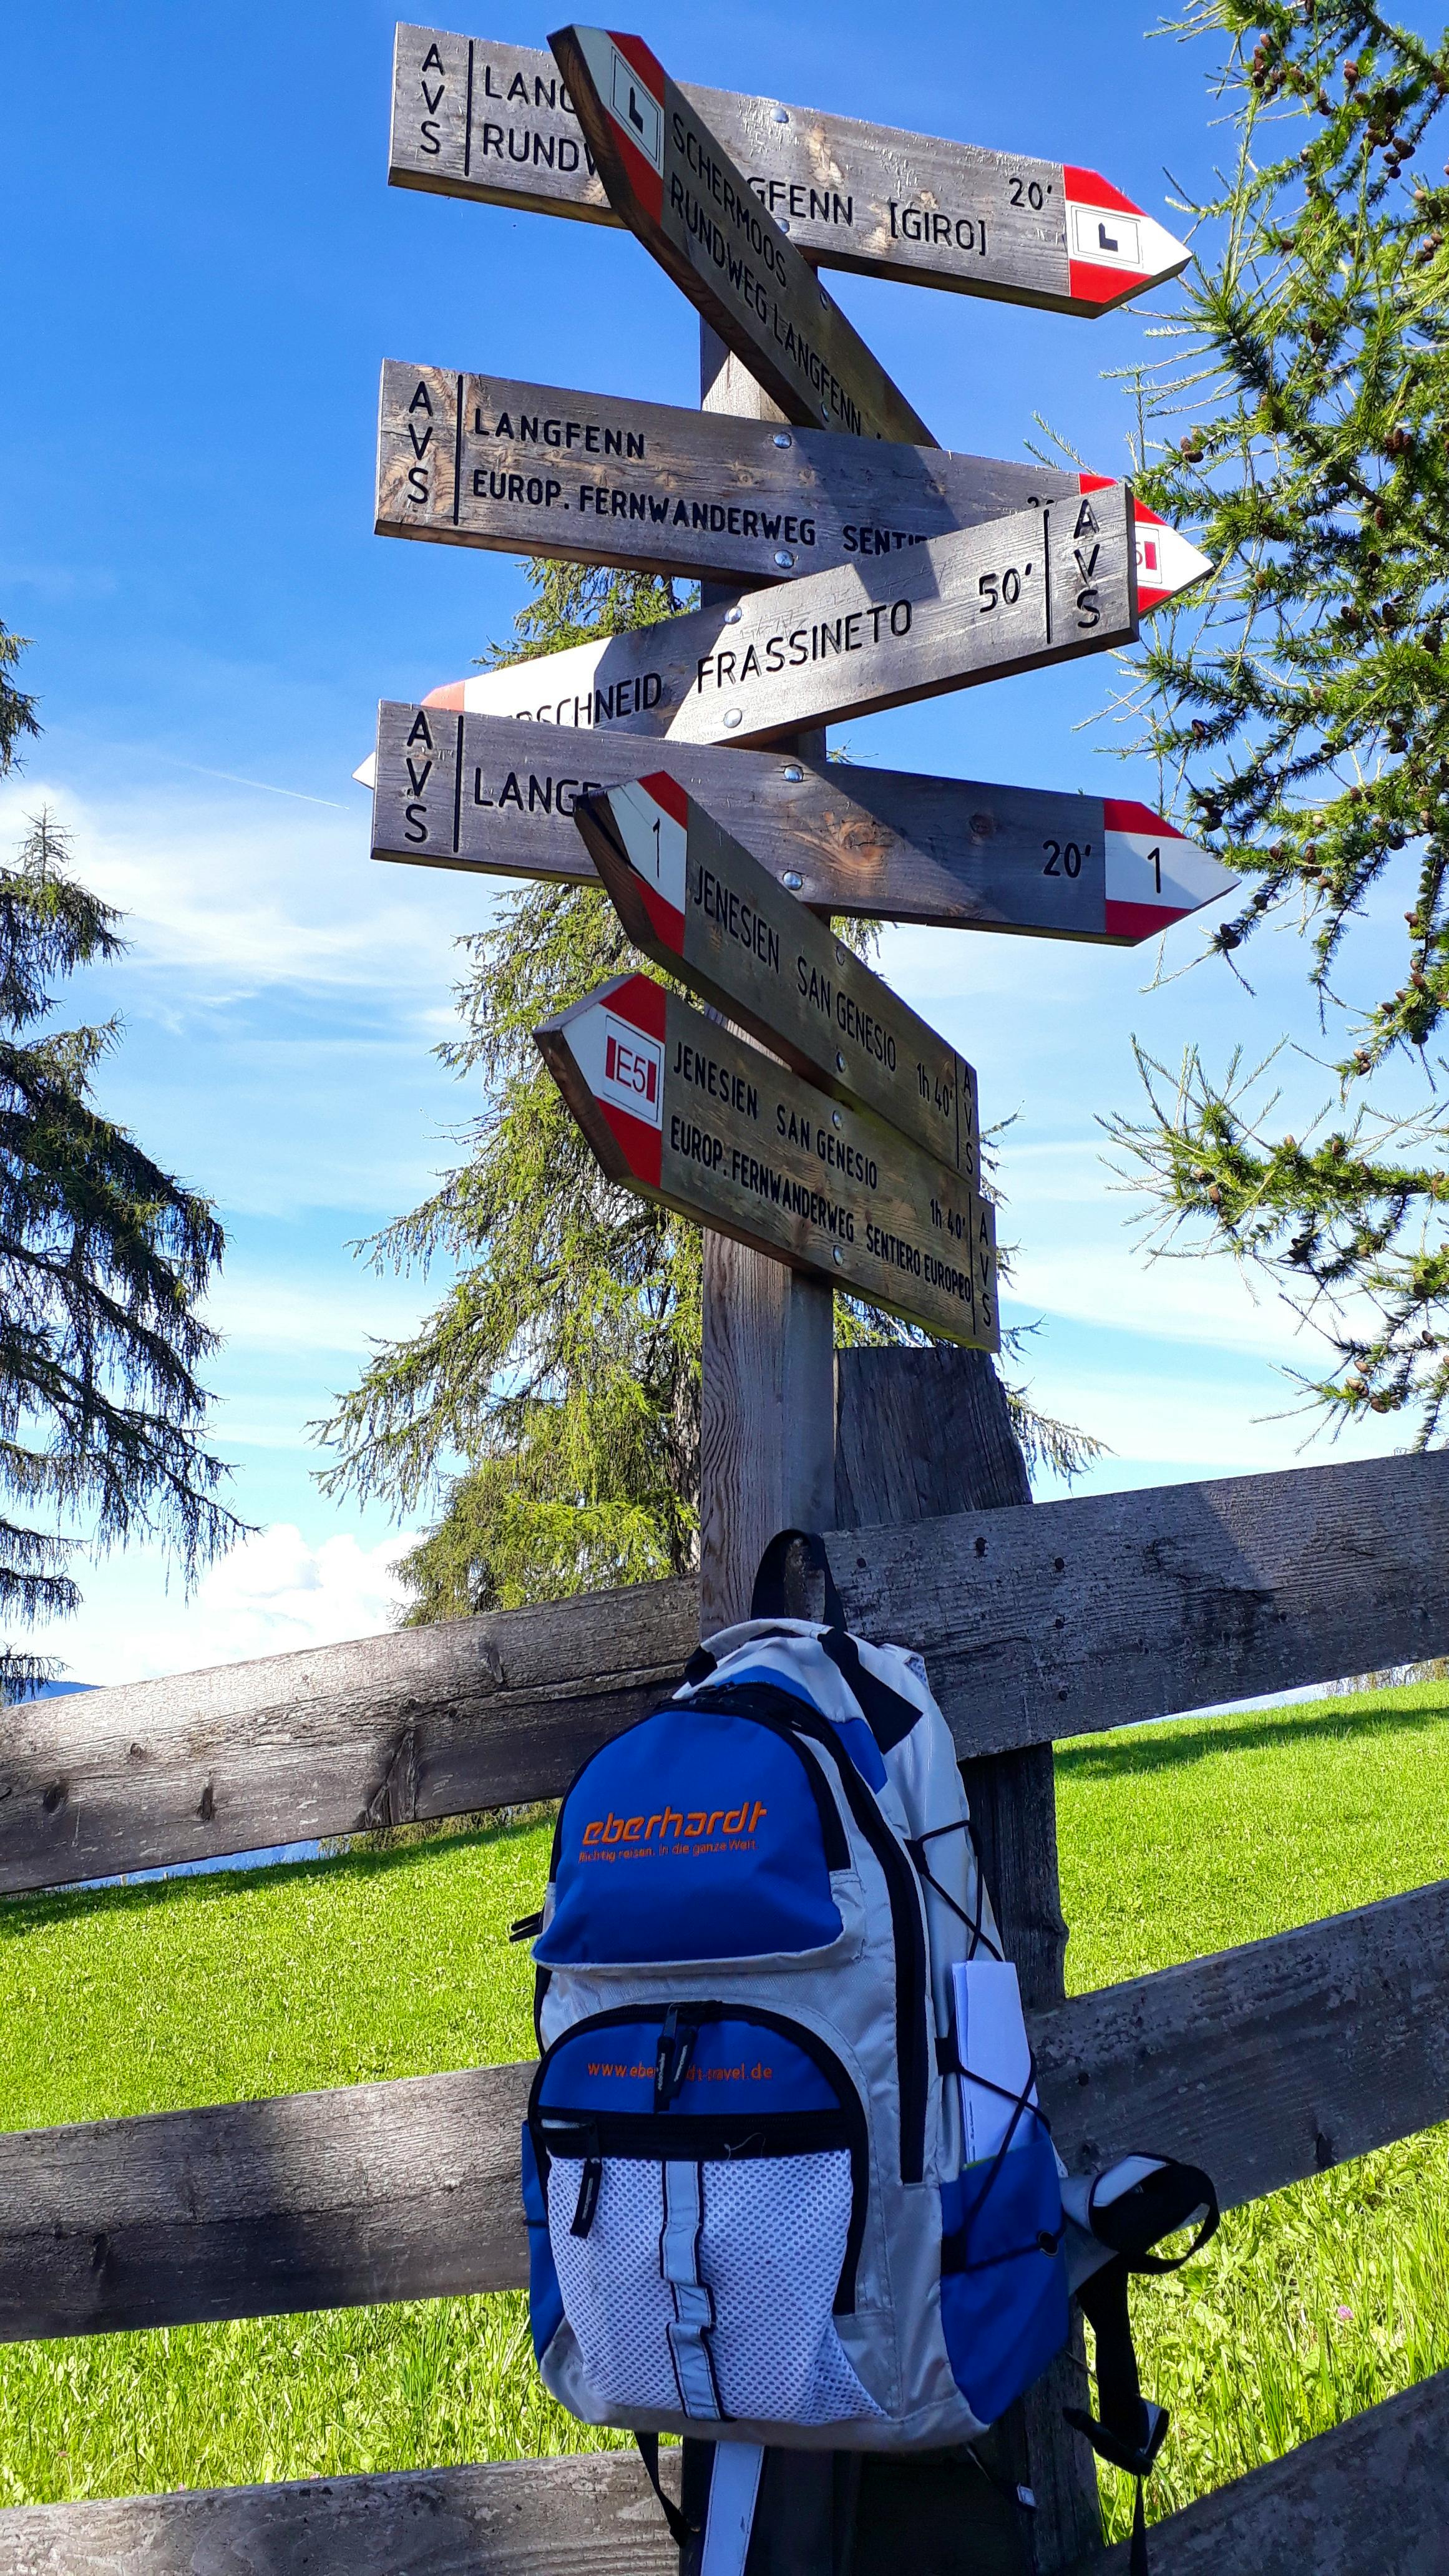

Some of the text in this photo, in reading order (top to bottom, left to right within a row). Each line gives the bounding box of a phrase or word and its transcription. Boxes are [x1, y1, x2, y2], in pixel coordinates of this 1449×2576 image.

[671, 112, 787, 288] SCHERMOOS
[747, 177, 852, 227] GFENN
[890, 202, 986, 255] [GIRO]
[1009, 177, 1052, 210] 20'
[670, 172, 861, 436] RUNDWEG LANGFENN
[475, 407, 645, 460] LANGFENN
[472, 469, 570, 510] EUROP.
[580, 485, 816, 546] FERNWANDERWEG
[696, 599, 912, 694] FRASSINETO
[978, 563, 1033, 614] 50'
[653, 817, 661, 878] 1
[1042, 840, 1091, 879] 20'
[1147, 847, 1161, 894] 1
[694, 866, 779, 974] JENESIEN
[797, 955, 831, 1018] SAN
[836, 991, 897, 1072] GENESIO
[917, 1062, 930, 1103] 1h
[673, 1041, 966, 1240] JENESIEN SAN GENESIO 1h 40'
[671, 1114, 971, 1304] EUROP. FERNWANDERWEG SENTIERO EUROPEO
[583, 1801, 768, 1846] eberhardt
[672, 1842, 690, 1855] die
[693, 1842, 726, 1856] ganze
